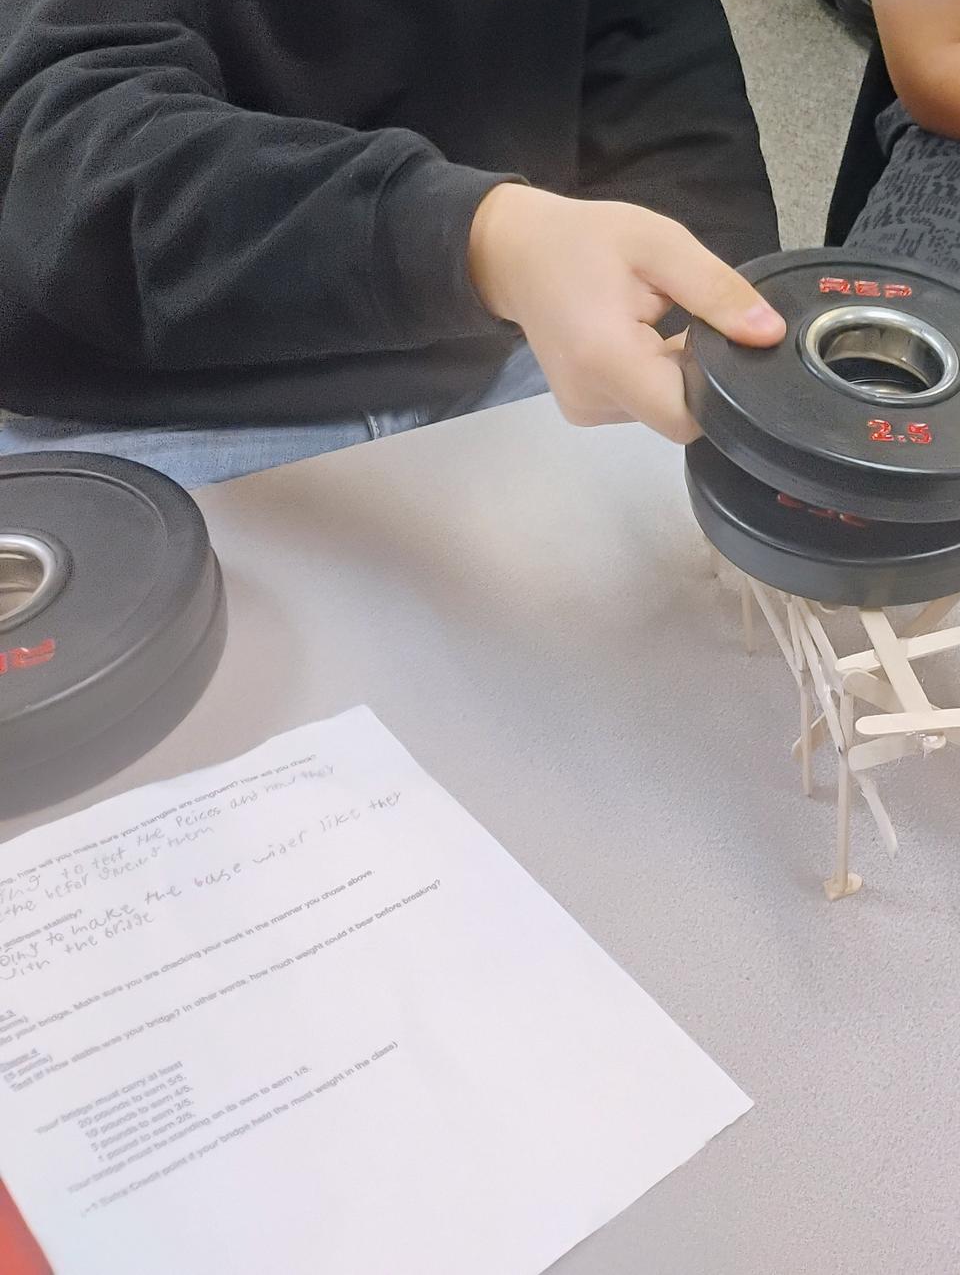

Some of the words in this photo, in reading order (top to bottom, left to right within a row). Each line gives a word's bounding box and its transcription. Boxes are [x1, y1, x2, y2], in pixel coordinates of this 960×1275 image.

[818, 277, 912, 298] REP
[867, 419, 932, 444] 2.5
[123, 1025, 144, 1040] your
[144, 1009, 180, 1028] bridge?
[194, 992, 217, 1006] other
[249, 969, 268, 980] how
[270, 957, 294, 972] much
[292, 943, 324, 961] weight
[325, 930, 347, 946] could
[354, 917, 373, 929] bear
[374, 903, 402, 919] before
[402, 879, 440, 904] breaking?
[124, 978, 142, 990] you
[144, 971, 160, 981] are
[161, 951, 201, 972] checking
[202, 942, 221, 955] your
[222, 933, 244, 944] work
[270, 904, 302, 924] manner
[304, 898, 320, 909] you
[321, 885, 346, 900] chose
